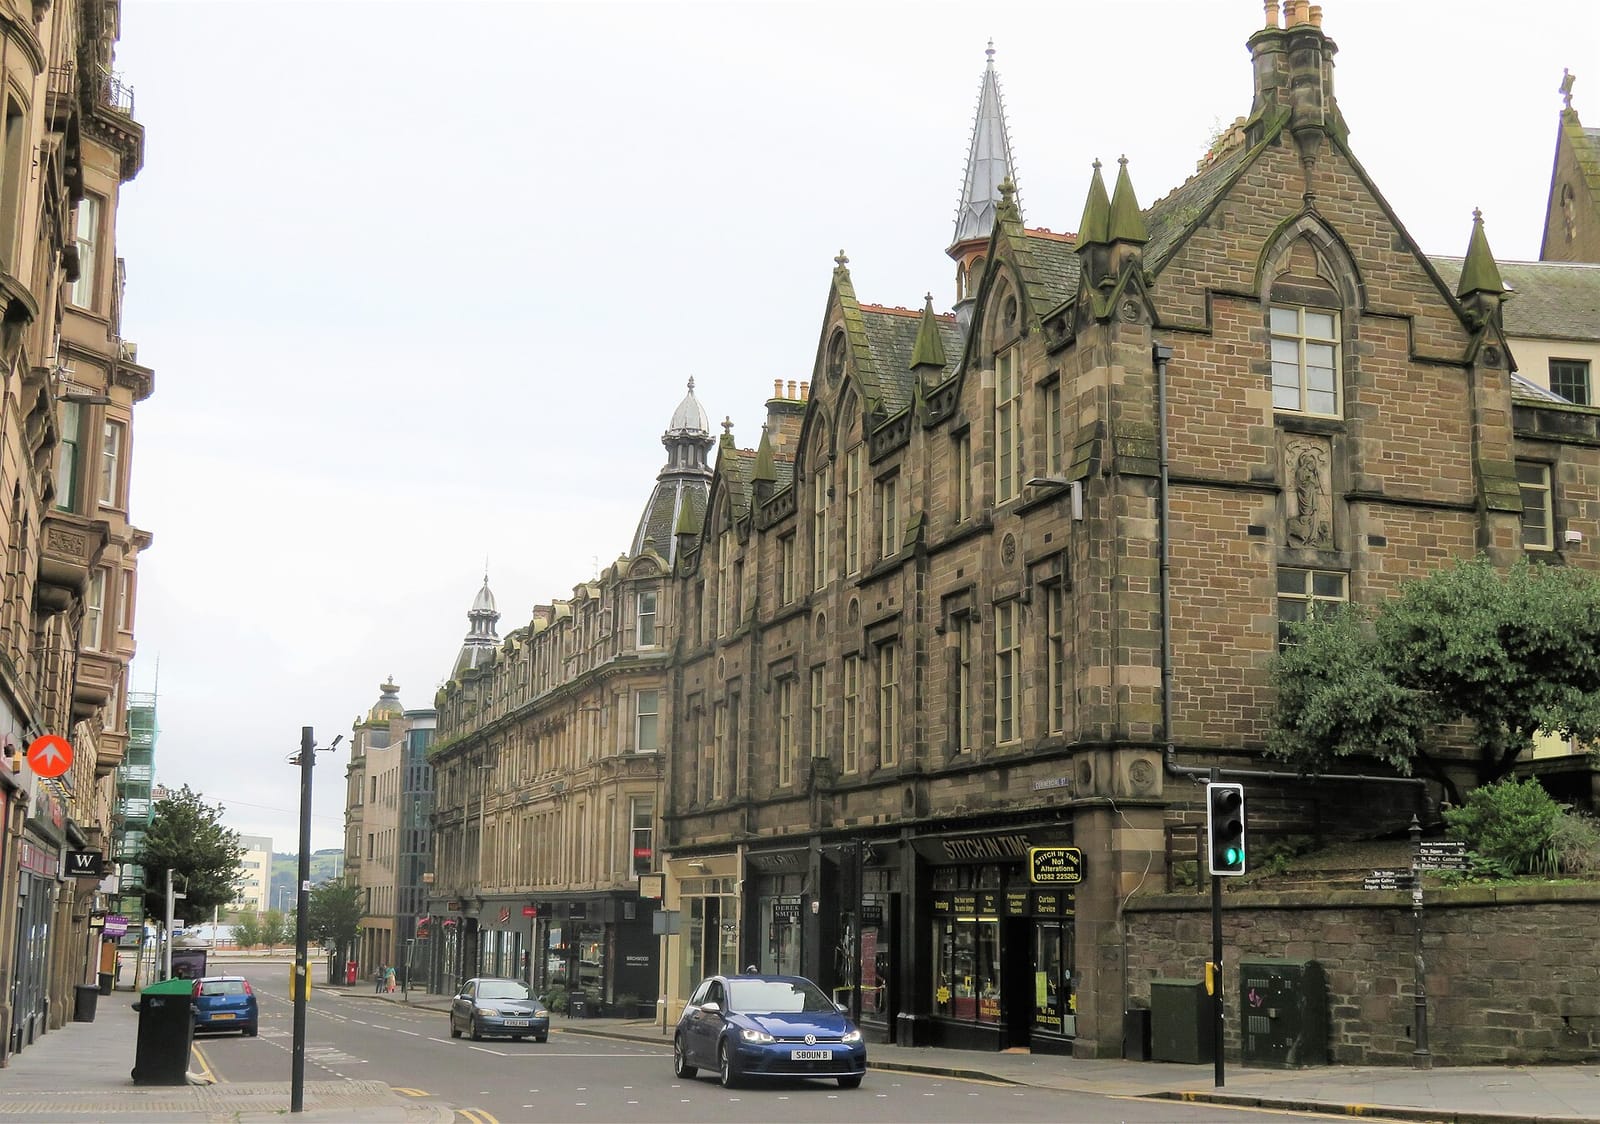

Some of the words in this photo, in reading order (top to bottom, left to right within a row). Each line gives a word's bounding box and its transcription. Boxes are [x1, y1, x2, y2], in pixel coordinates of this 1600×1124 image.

[943, 838, 988, 859] STITCH
[984, 837, 1003, 857] IN
[75, 854, 94, 867] W
[1035, 850, 1056, 866] STITCH
[1065, 852, 1080, 866] TIME
[1051, 858, 1065, 866] No1
[1038, 895, 1056, 903] Curtain
[1038, 904, 1056, 913] Service
